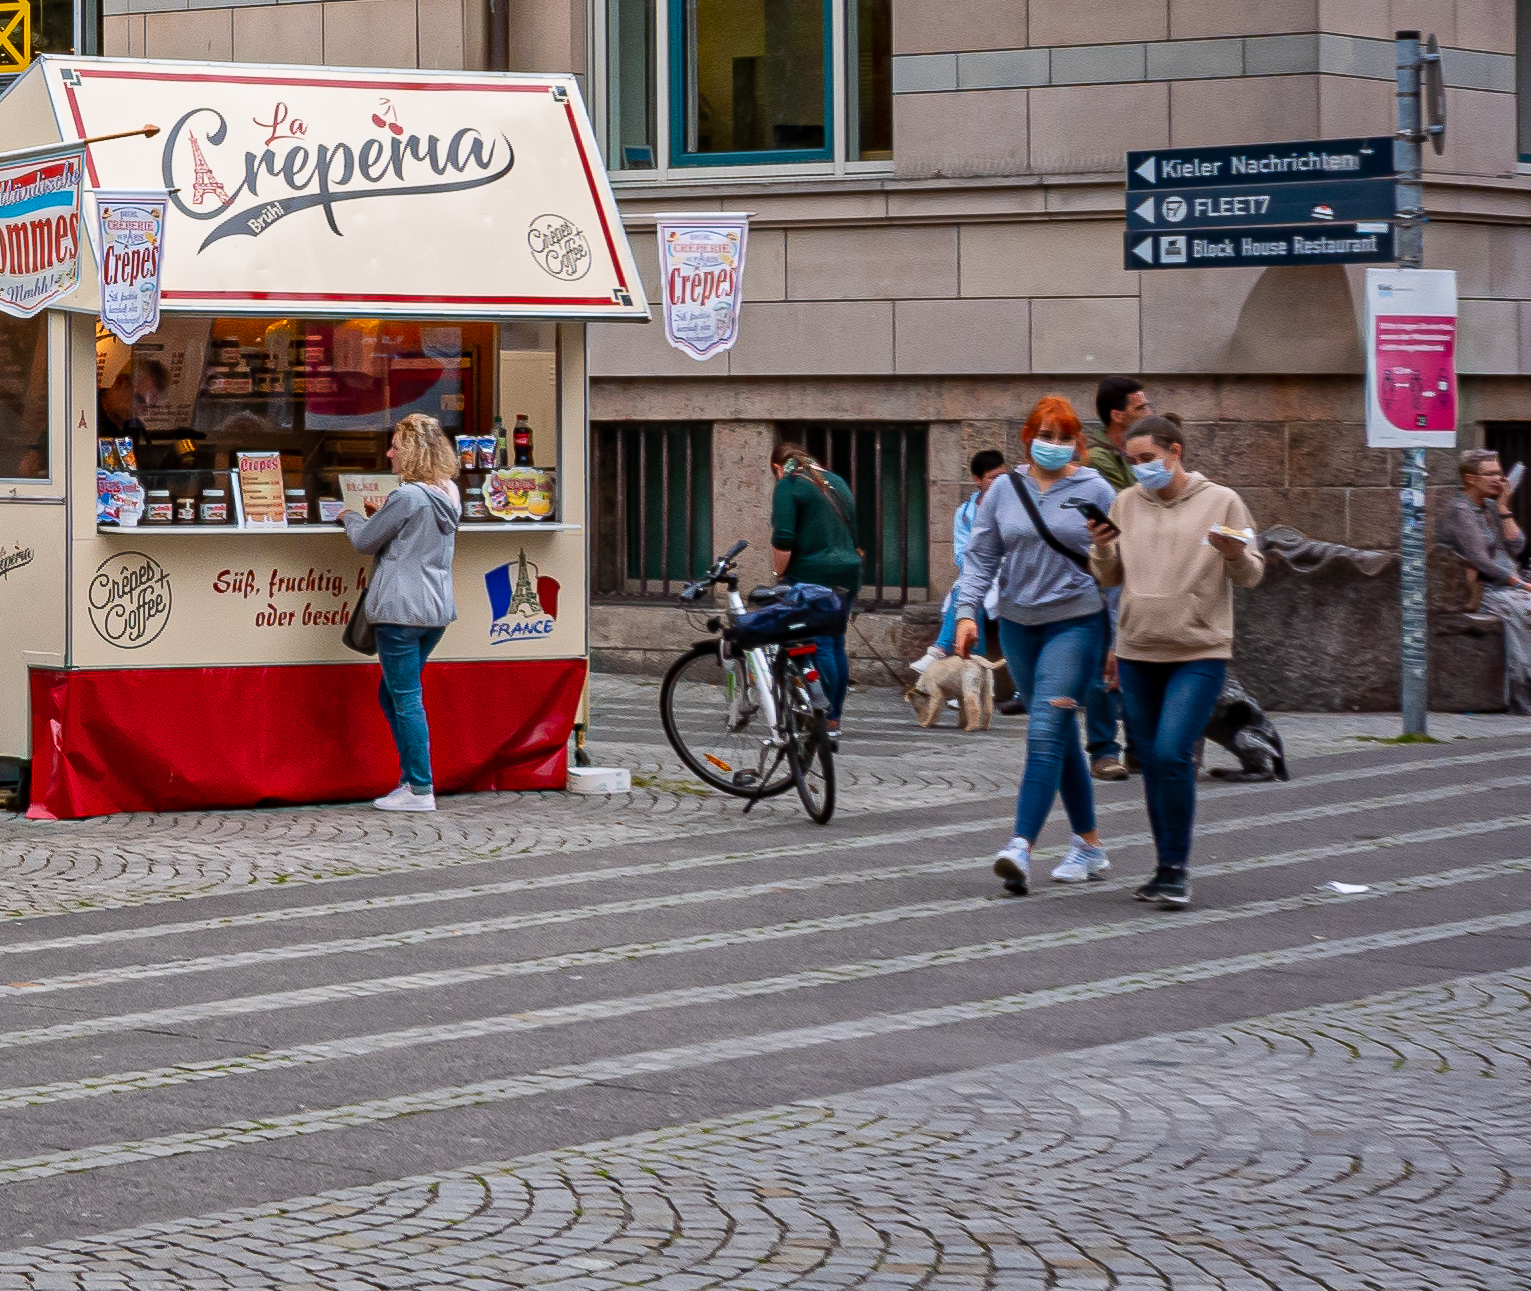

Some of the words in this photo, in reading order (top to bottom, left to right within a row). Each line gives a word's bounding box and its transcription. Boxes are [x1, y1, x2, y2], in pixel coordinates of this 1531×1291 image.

[252, 101, 309, 146] La
[1161, 159, 1223, 178] Kieler
[1231, 152, 1361, 175] Nachrichten
[247, 201, 285, 234] Brühl
[1194, 196, 1270, 217] FLEET7
[546, 238, 588, 276] Coffee
[1192, 239, 1235, 257] Block
[1242, 238, 1288, 256] House
[1293, 235, 1378, 255] Restaurant
[104, 243, 160, 286] Crêpes
[6, 274, 55, 302] Mmhh!
[669, 266, 737, 306] Crêpes
[89, 560, 156, 609] Crêpes
[212, 568, 261, 599] Süß,
[268, 567, 350, 599] fruchtig,
[105, 585, 166, 642] Coffee
[255, 603, 295, 628] oder
[490, 619, 554, 638] FRANCE
